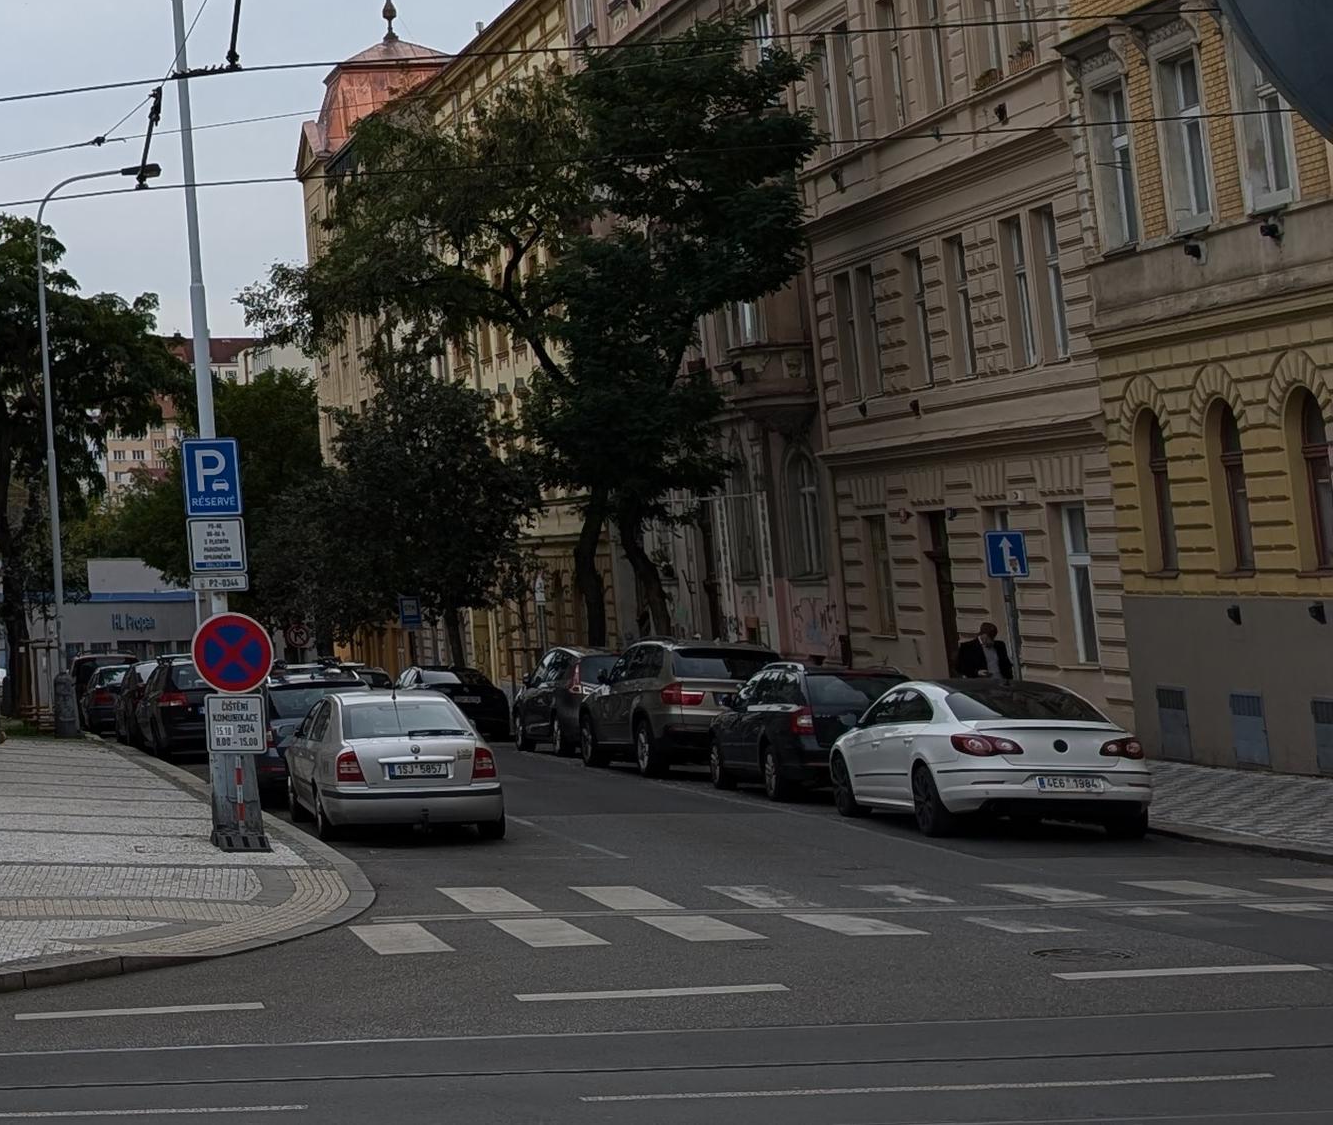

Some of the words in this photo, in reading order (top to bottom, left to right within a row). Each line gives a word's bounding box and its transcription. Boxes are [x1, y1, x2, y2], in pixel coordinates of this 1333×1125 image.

[194, 449, 226, 492] P
[192, 495, 236, 506] RÉSERVÉ
[213, 714, 259, 722] KOMUNIKACE
[237, 724, 255, 733] 2024
